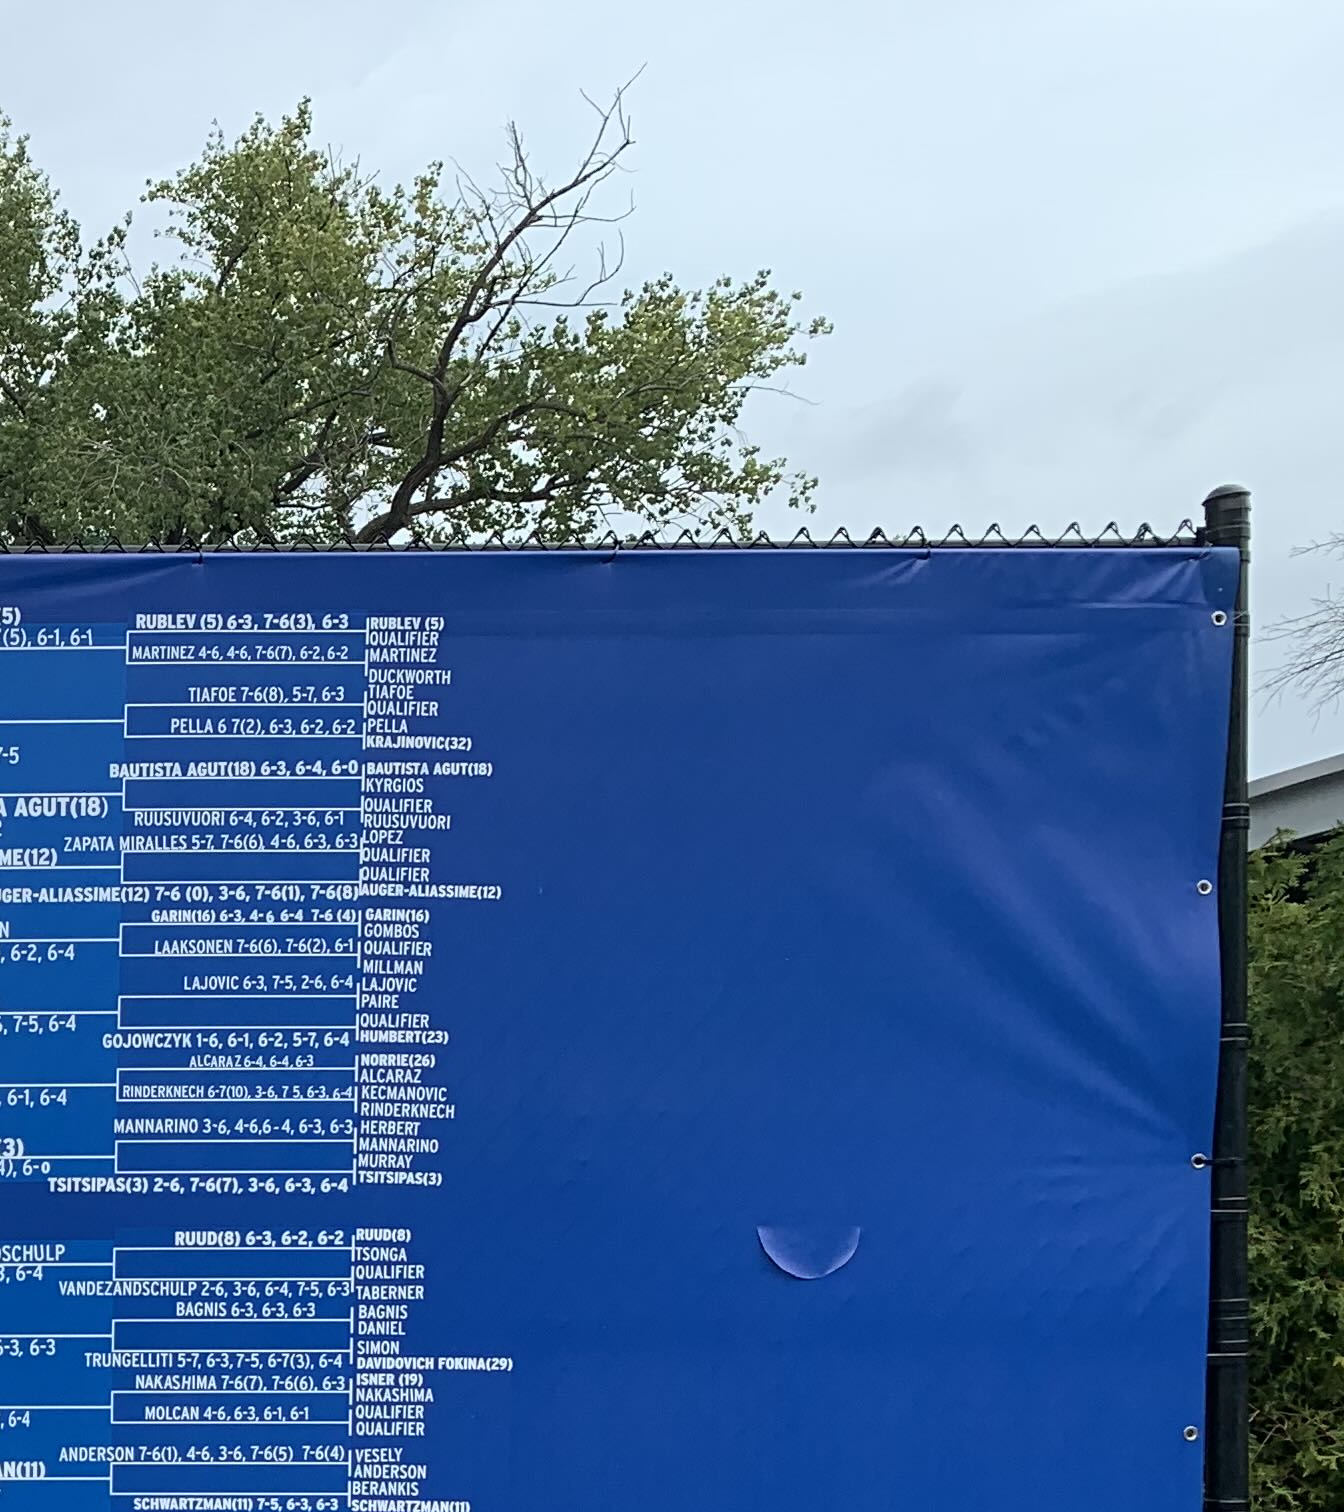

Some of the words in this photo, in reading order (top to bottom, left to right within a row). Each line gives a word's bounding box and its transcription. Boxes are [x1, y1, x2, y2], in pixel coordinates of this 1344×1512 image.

[369, 647, 437, 663] MARTINEZ
[368, 668, 452, 687] DUCKWORTH
[367, 718, 408, 734] PELLA
[366, 735, 472, 752] KRAJINOVIC(32)
[366, 777, 424, 793] KYRGIOS
[13, 796, 109, 819] AGUT(18)
[365, 907, 430, 926] GARIN(16)
[363, 959, 424, 975] MILLMAN
[361, 976, 417, 993] LAJOVIC
[361, 993, 400, 1009] PAIRE
[360, 1053, 436, 1069] NORRIE(26)
[361, 1085, 448, 1102] KECMANOVIC
[360, 1102, 455, 1119] RINDERKNECH
[360, 1119, 421, 1137] HERBERT
[355, 1227, 412, 1243] RUUD(8)
[355, 1285, 425, 1301] TABERNER
[355, 1387, 434, 1403] NAKASHIMA
[354, 1447, 403, 1463] VESELY
